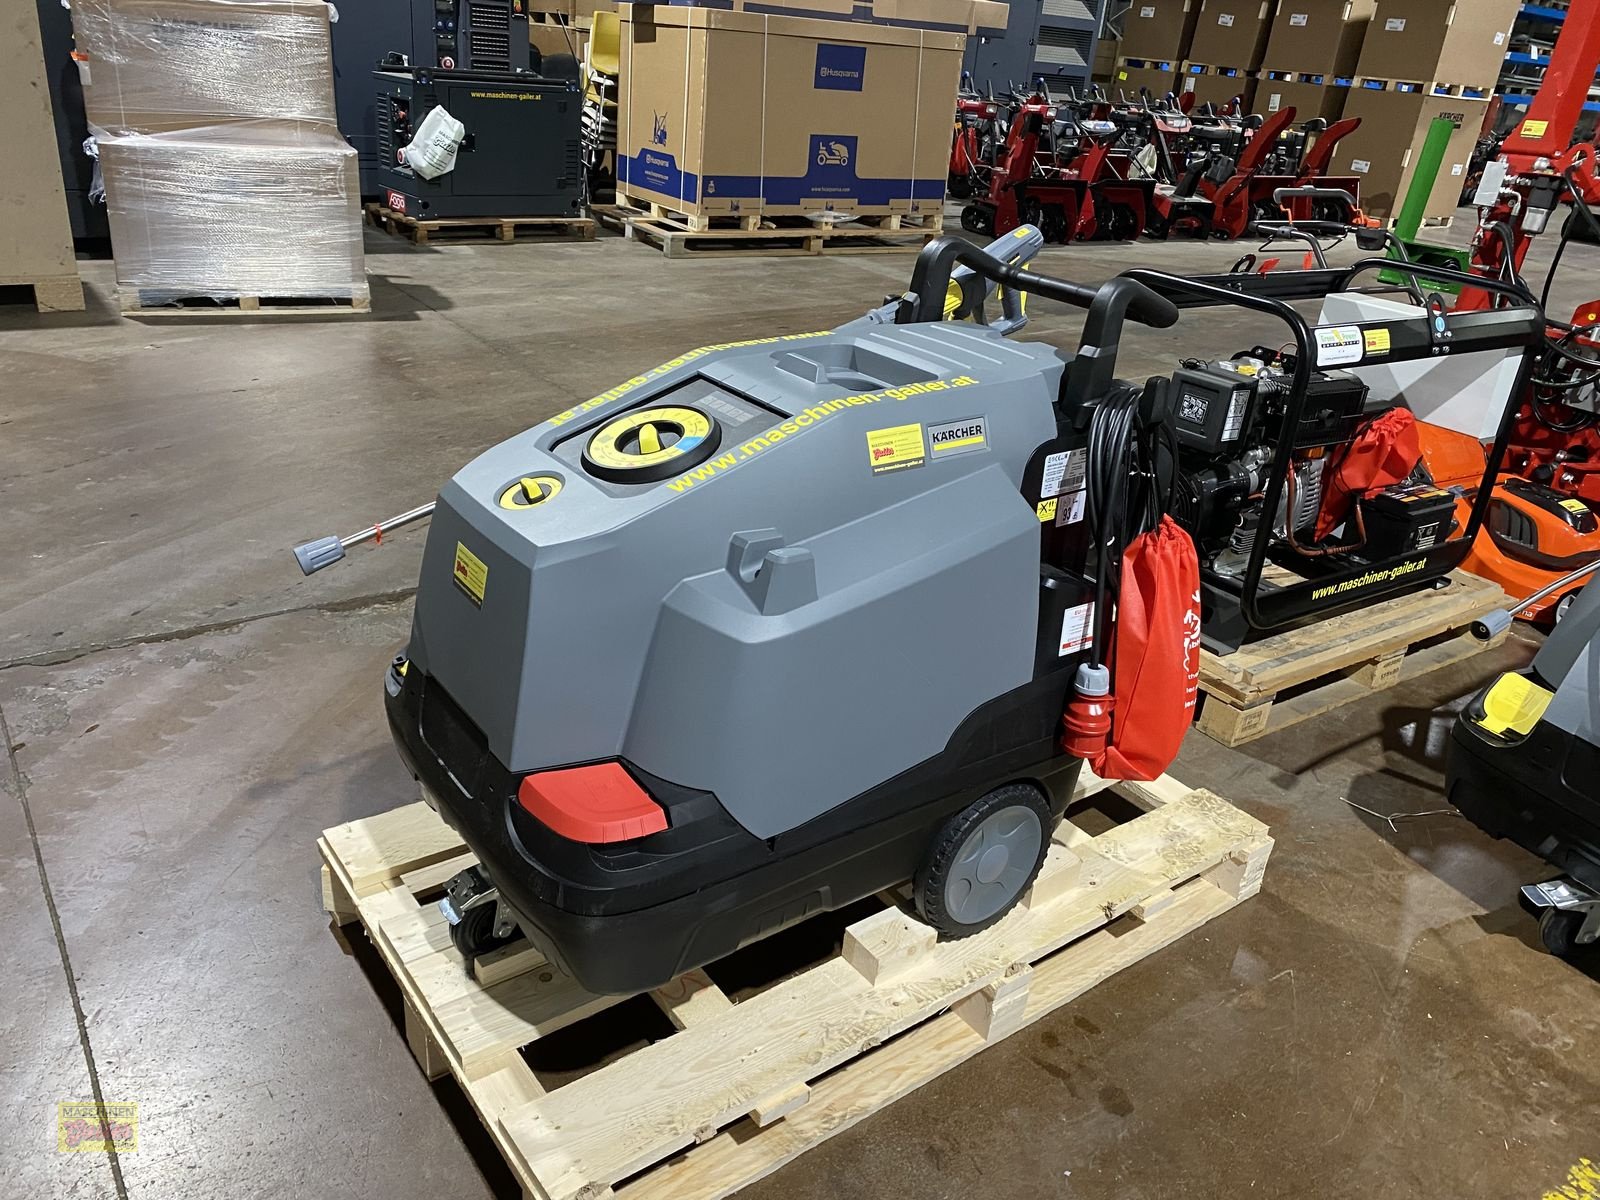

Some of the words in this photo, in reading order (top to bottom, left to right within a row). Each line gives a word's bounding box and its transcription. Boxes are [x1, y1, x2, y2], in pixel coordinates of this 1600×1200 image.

[826, 67, 859, 78] Husqvarna
[470, 91, 542, 101] www.maschinen-gailer.at
[667, 374, 979, 493] www.maschinen-gailer.at
[932, 424, 983, 443] KÄRCHER
[1311, 557, 1427, 600] www.maschinen-gailer.at
